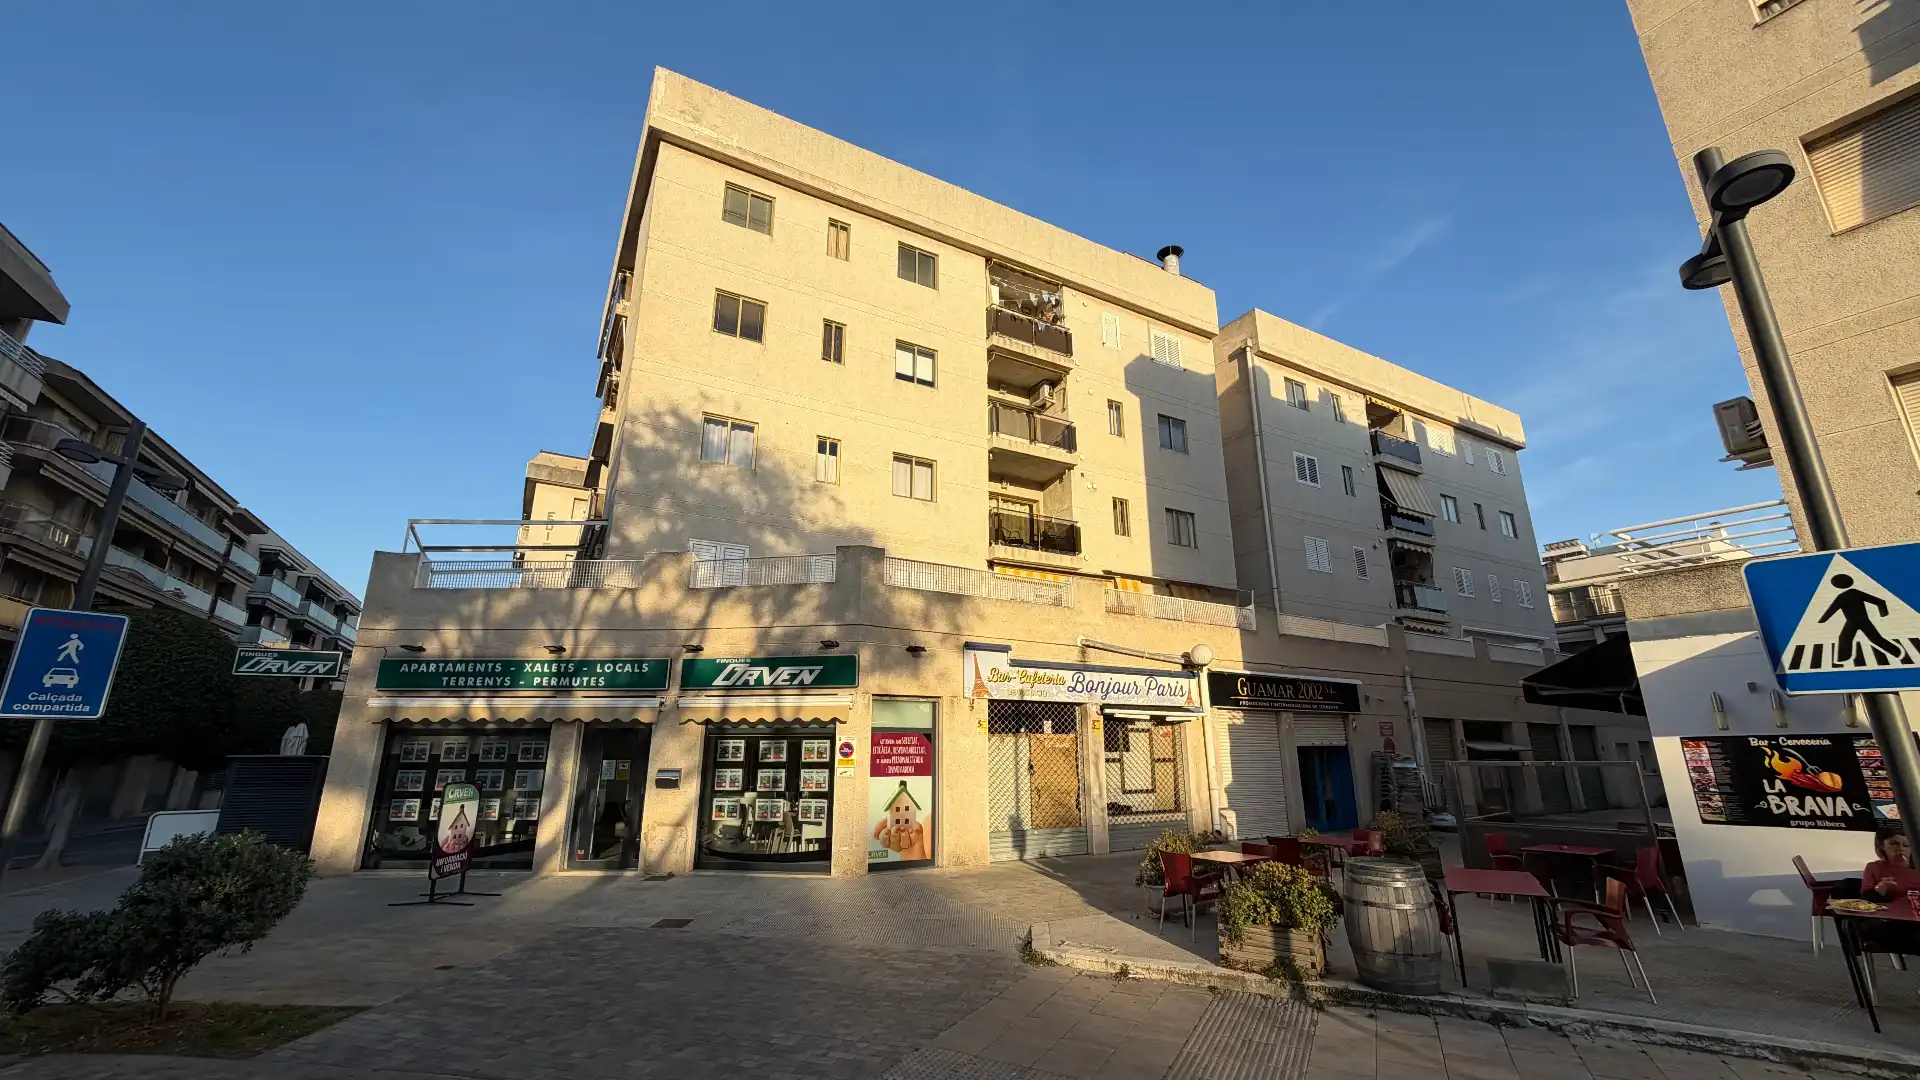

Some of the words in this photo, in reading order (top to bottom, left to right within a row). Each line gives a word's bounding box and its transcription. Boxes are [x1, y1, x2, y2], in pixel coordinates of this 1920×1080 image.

[400, 663, 502, 672] APARTAMENTS
[524, 663, 575, 672] XALETS
[596, 663, 649, 672] LOCALS
[442, 676, 511, 686] TERRENYS
[533, 676, 605, 686] PERMUTES
[1067, 671, 1141, 700] Bonjour
[1144, 676, 1187, 697] Paris
[1237, 678, 1295, 698] GUAMAR
[1297, 682, 1323, 700] 2002
[28, 692, 82, 703] Calçada
[13, 703, 90, 712] compartida
[1748, 737, 1768, 746] Bar
[1762, 779, 1787, 793] LA
[1766, 794, 1854, 817] BRAVA
[1790, 820, 1815, 828] grupo
[1816, 820, 1846, 828] Ribera
